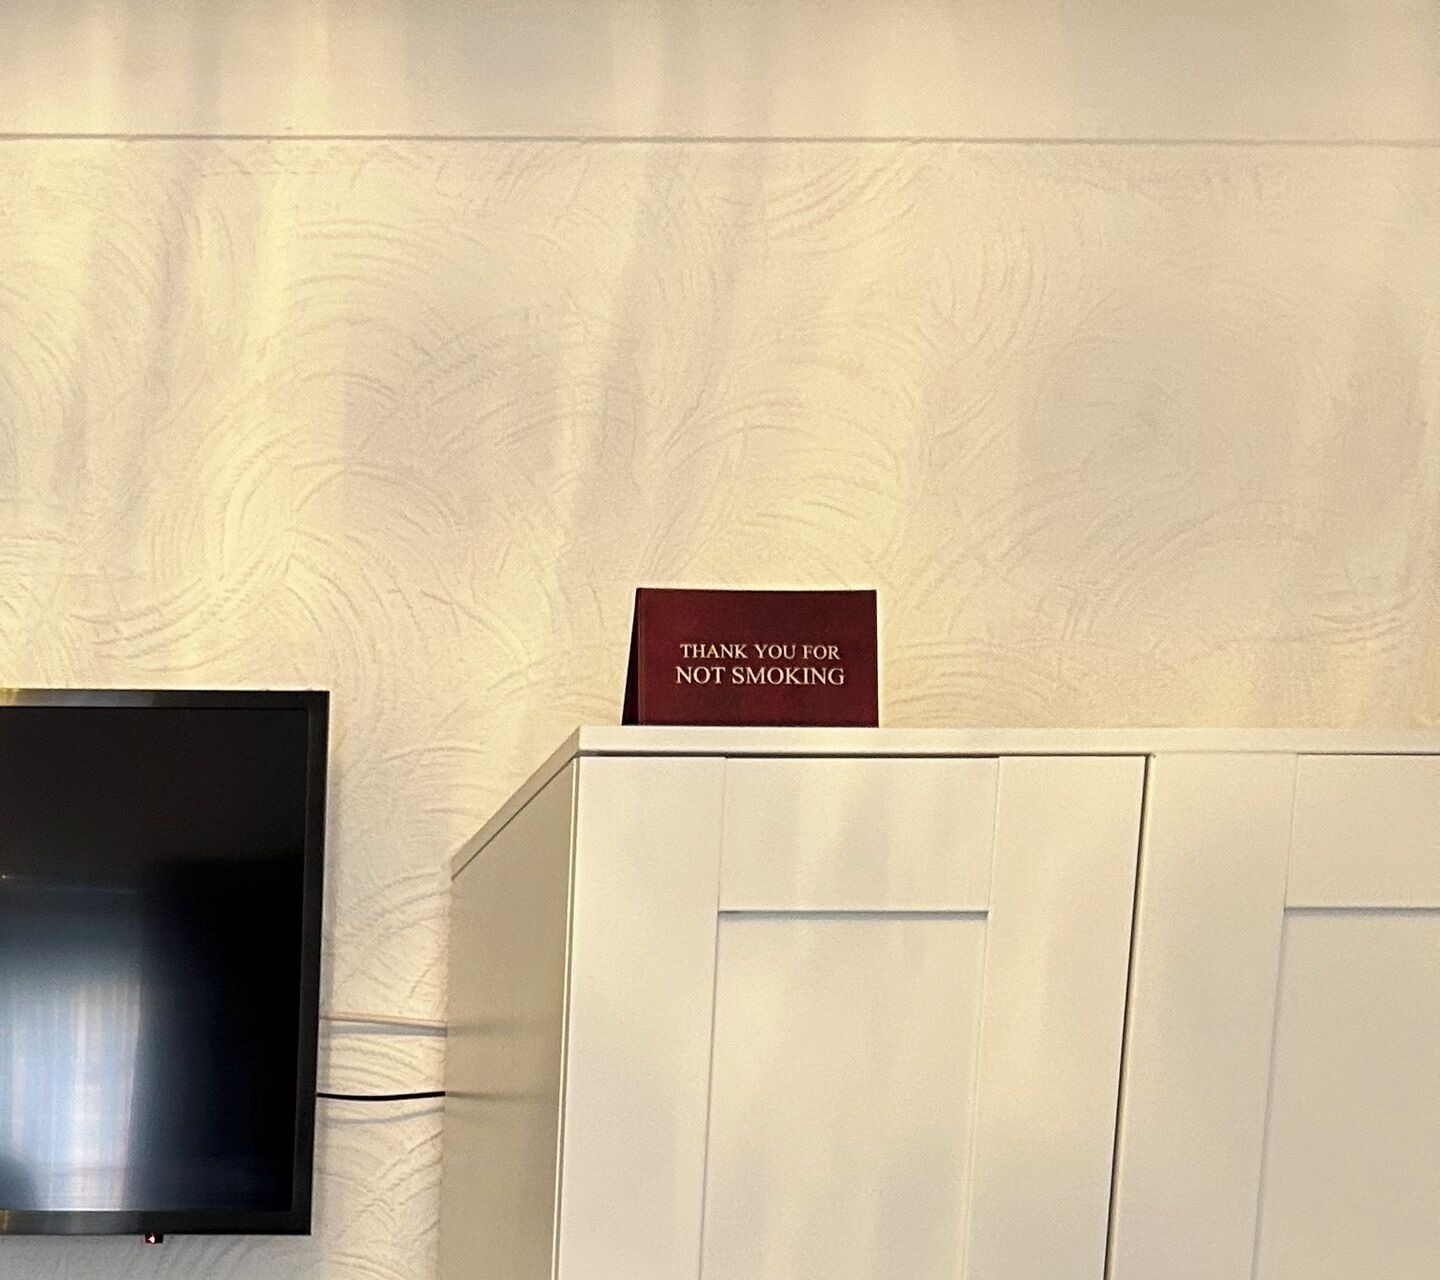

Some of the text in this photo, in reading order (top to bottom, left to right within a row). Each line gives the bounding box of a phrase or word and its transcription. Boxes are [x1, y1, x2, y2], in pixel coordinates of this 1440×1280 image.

[679, 644, 841, 660] THANK YOU FOR
[675, 666, 845, 686] NOT SMOKING
